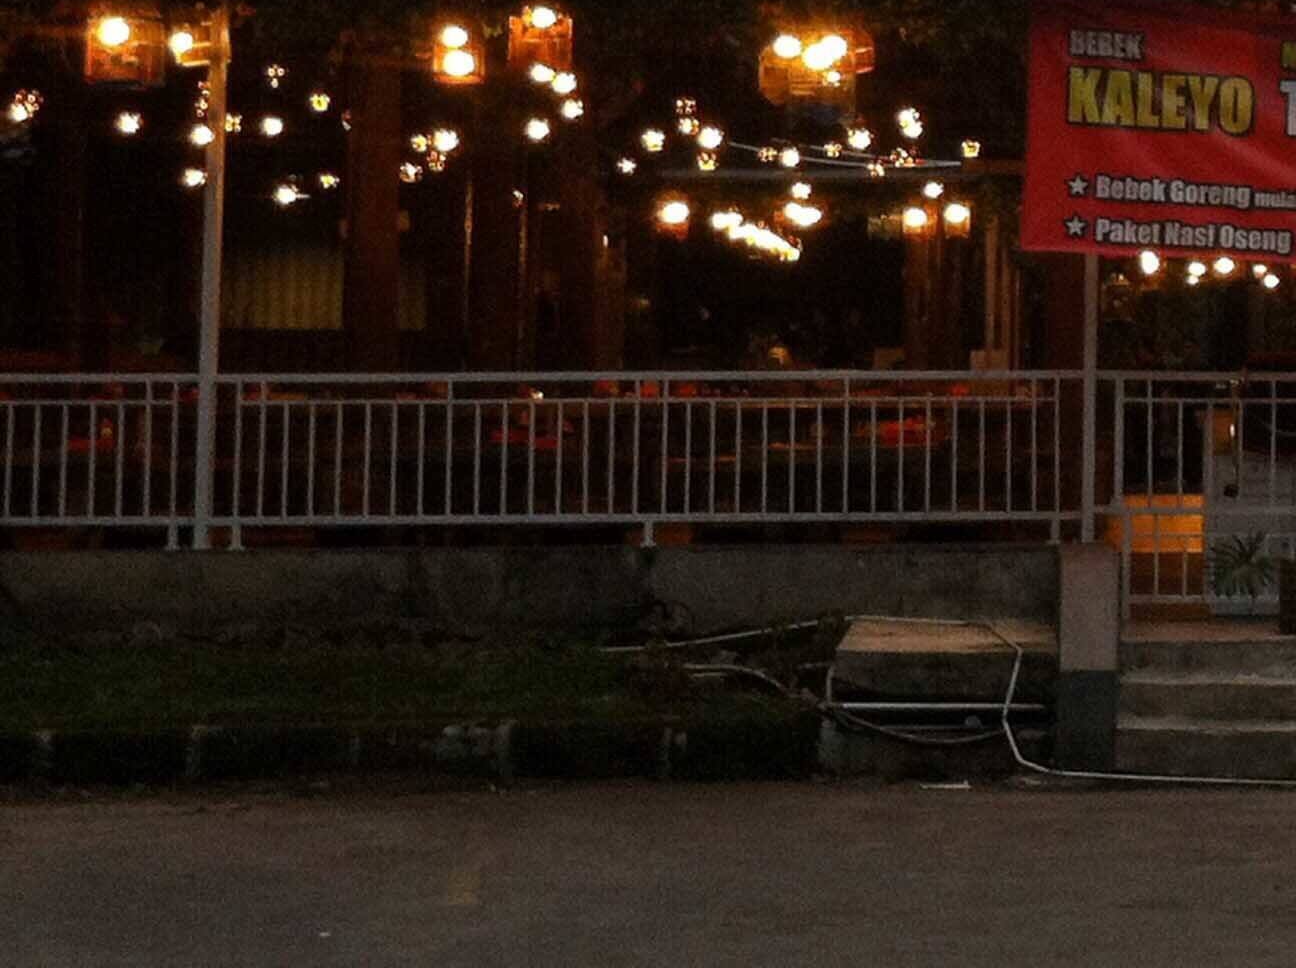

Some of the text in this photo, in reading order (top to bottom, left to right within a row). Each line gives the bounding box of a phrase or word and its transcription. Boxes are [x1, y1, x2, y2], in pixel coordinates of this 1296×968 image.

[1068, 30, 1143, 60] BEBEK
[1068, 66, 1254, 134] KALEYO
[1096, 175, 1166, 203] Bebek
[1169, 180, 1251, 209] Goreng
[1096, 218, 1161, 245] Paket
[1164, 220, 1215, 248] Nasi
[1219, 224, 1292, 255] Oseng
